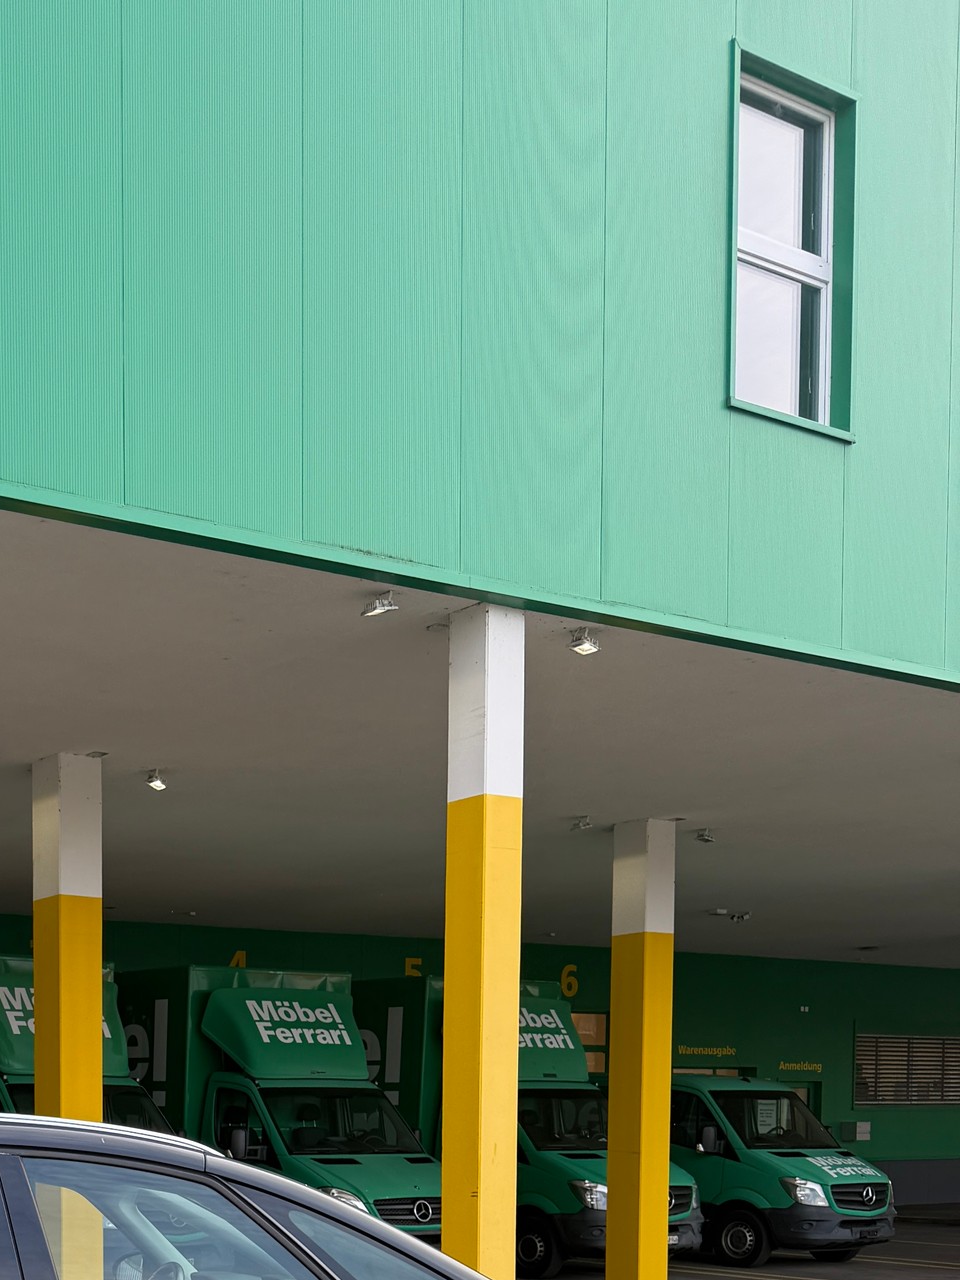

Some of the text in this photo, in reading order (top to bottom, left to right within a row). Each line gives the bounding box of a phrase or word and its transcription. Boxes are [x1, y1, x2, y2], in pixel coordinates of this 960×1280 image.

[560, 963, 579, 998] 6
[245, 999, 342, 1024] Möbel
[255, 1021, 352, 1045] Ferrari
[677, 1045, 736, 1057] Warenausgabe
[778, 1060, 822, 1073] Anmeldung
[821, 1166, 882, 1178] Ferrari
